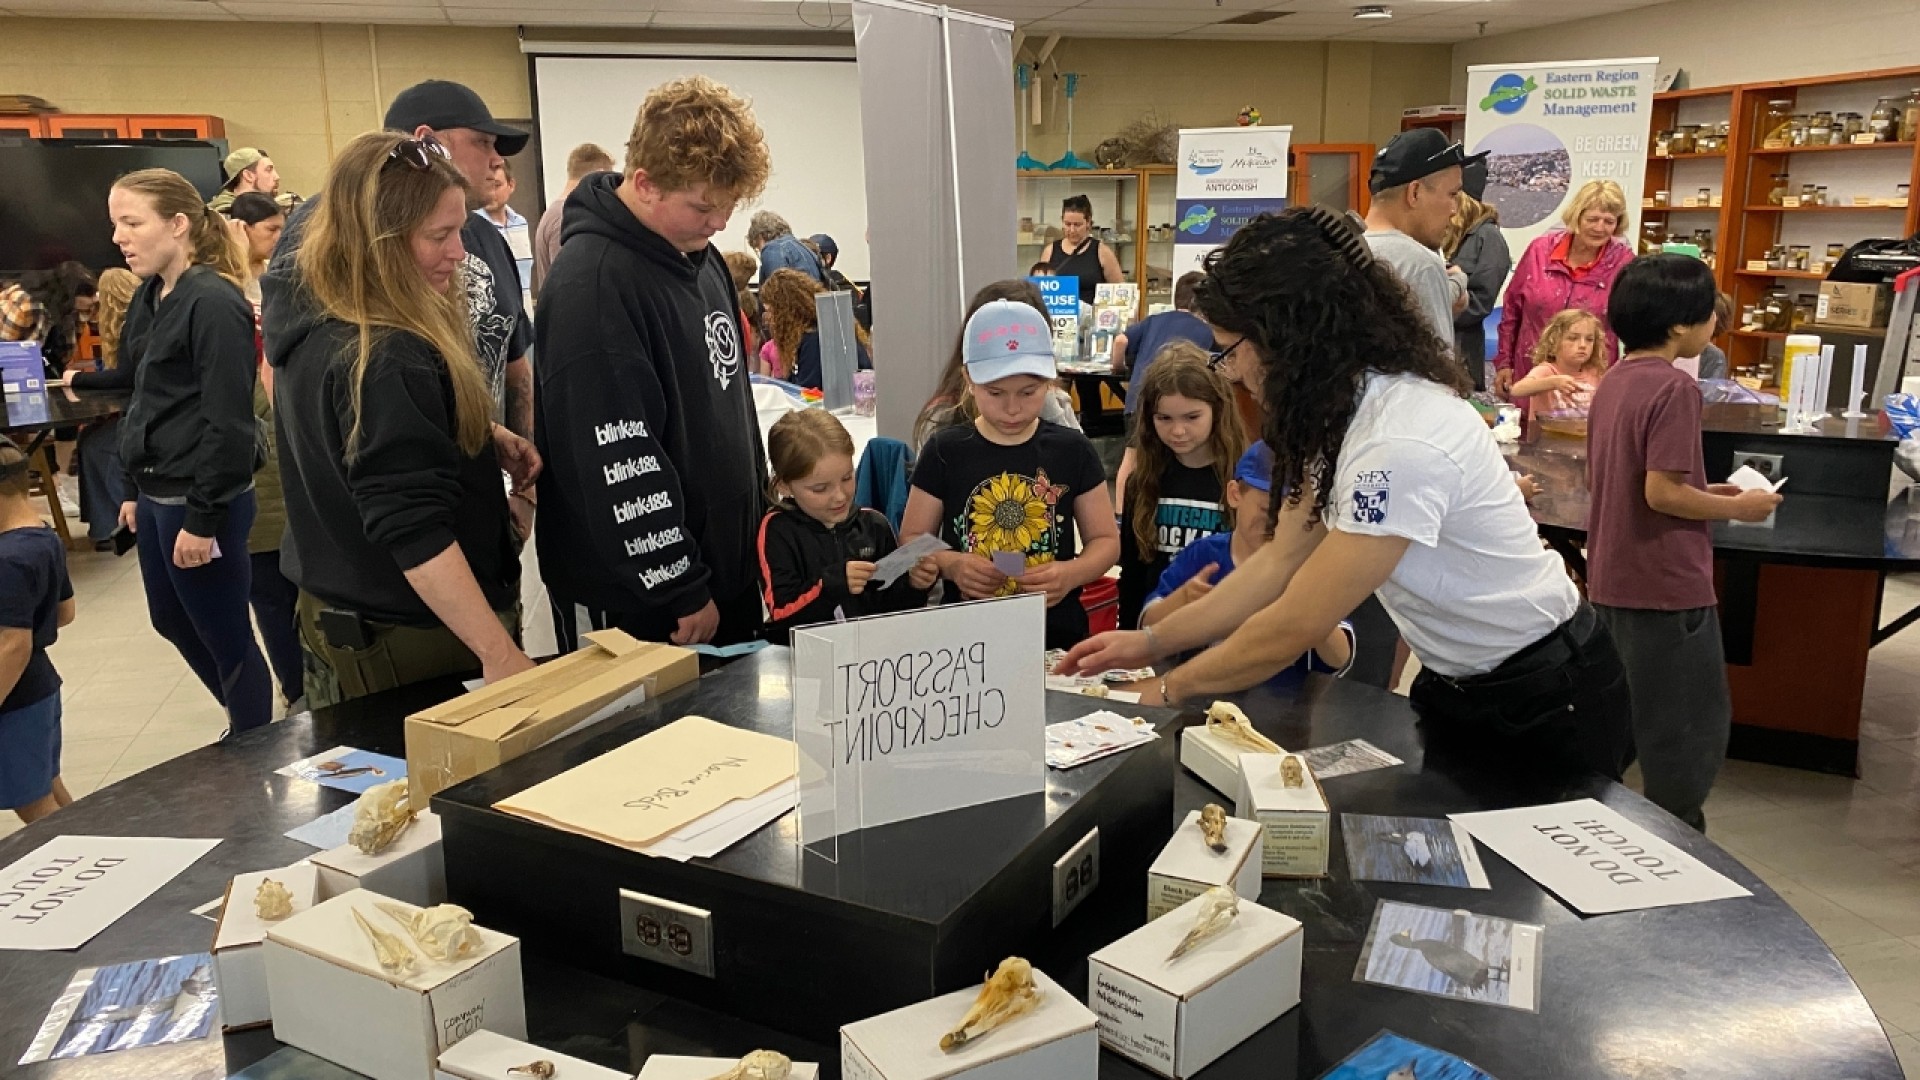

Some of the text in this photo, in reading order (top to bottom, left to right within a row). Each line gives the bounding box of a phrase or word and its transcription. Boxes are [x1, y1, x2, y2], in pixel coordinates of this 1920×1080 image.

[1545, 69, 1639, 84] Eastern Region
[1544, 85, 1636, 100] SOLID WASTE
[1543, 101, 1637, 118] Management
[1575, 135, 1594, 153] BE
[1582, 159, 1632, 178] KEEP IT
[1205, 183, 1258, 192] ANTIGONISH
[1040, 280, 1060, 292] NO
[1042, 295, 1077, 306] CUSE
[603, 455, 662, 487] blink-182
[613, 490, 673, 525] blink-182
[1532, 823, 1644, 886] DO NOT
[1572, 819, 1684, 881] TOUCH!
[12, 856, 129, 925] DO NOT
